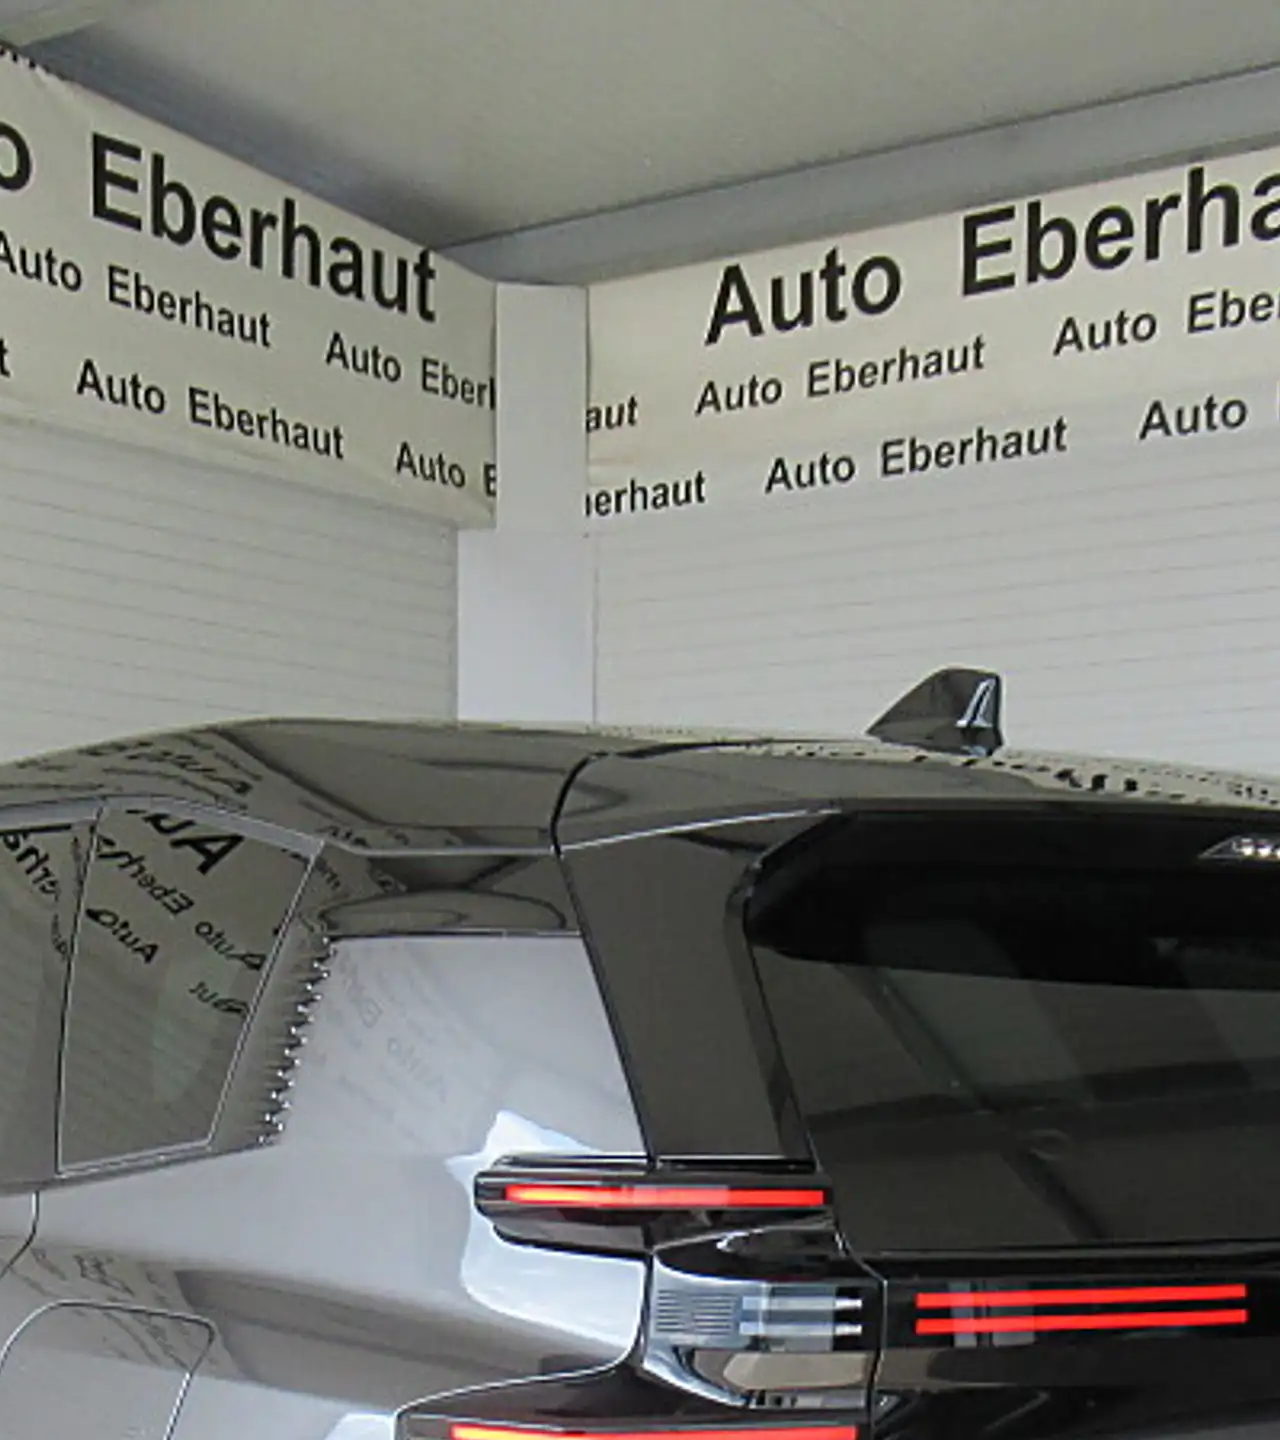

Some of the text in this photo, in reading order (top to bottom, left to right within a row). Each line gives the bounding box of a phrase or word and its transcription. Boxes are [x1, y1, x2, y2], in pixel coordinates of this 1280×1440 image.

[91, 131, 437, 323] Eberhaut
[107, 263, 271, 349] Eberhaut
[704, 247, 901, 346] Auto
[1053, 310, 1157, 356] Auto
[325, 331, 402, 384] Auto
[695, 336, 985, 415] Auto Eberhaut
[76, 358, 344, 461] Auto Eberhaut
[1139, 395, 1248, 441] Auto
[395, 440, 466, 490] Auto
[765, 416, 1067, 494] Auto Eberhaut
